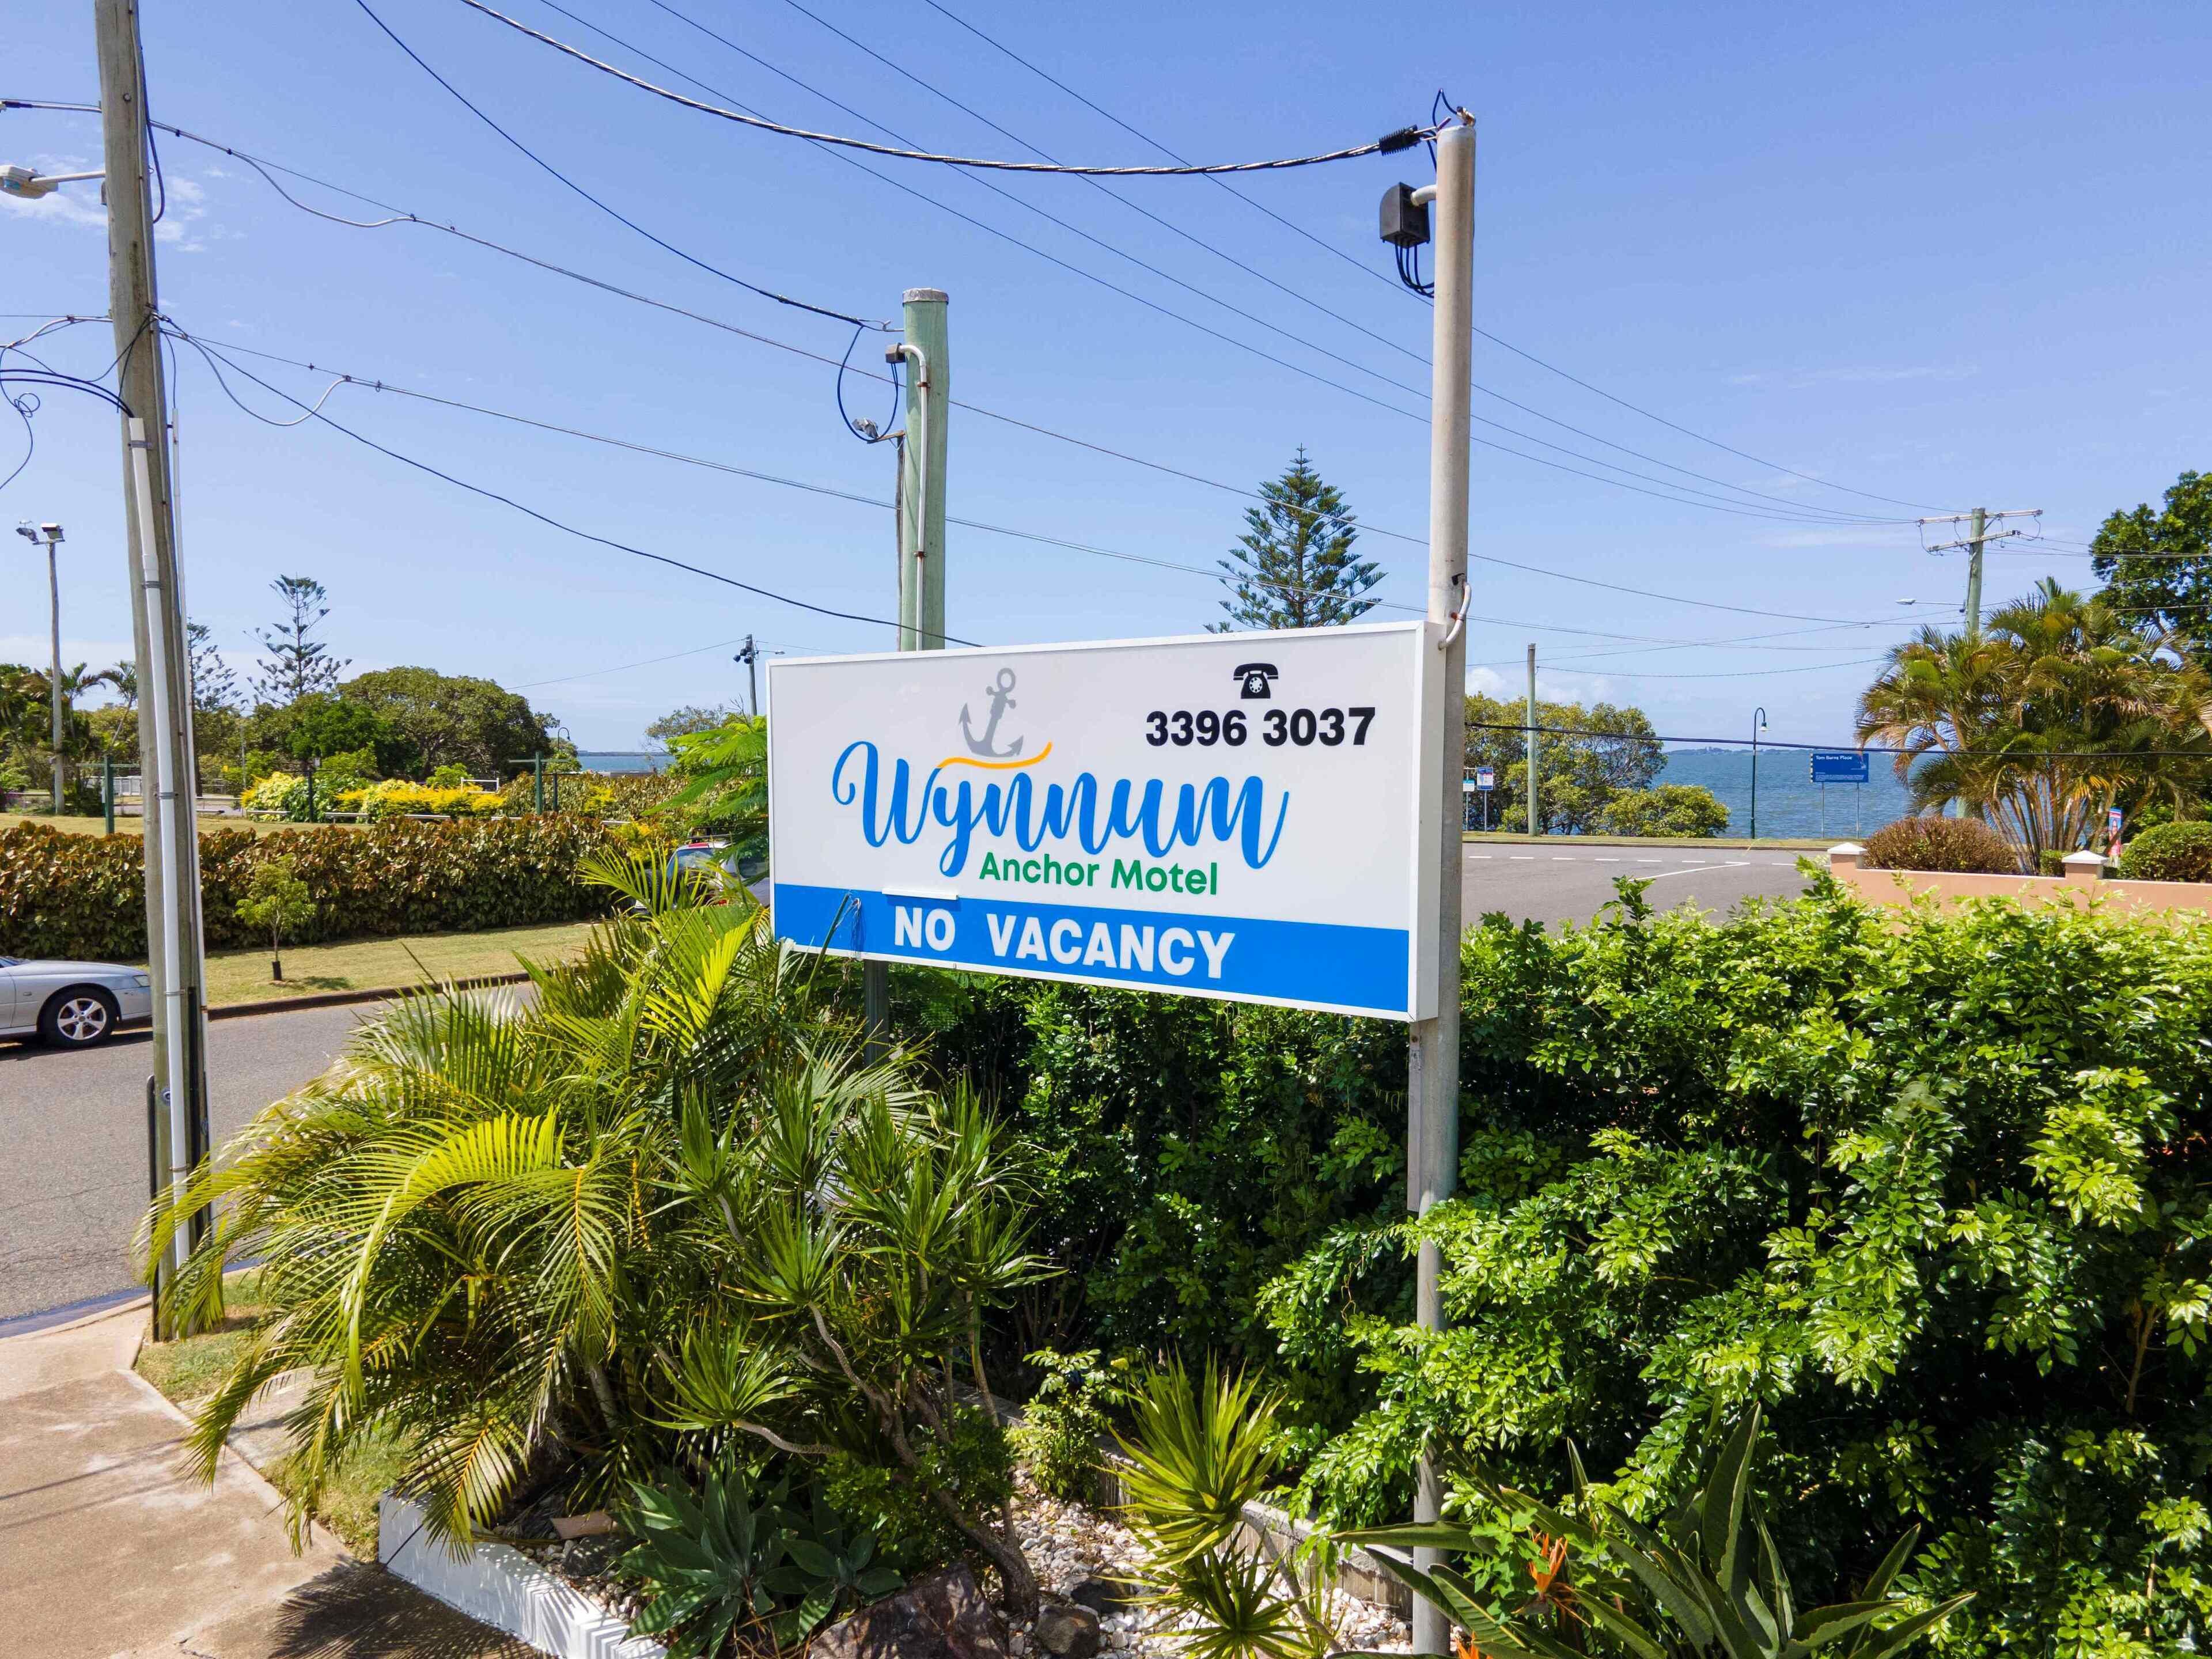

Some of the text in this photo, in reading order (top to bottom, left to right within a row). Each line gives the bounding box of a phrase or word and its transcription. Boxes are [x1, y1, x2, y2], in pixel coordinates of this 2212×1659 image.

[1146, 707, 1376, 747] 3396 3037
[832, 740, 1290, 878] Wynnum
[979, 851, 1218, 895] Anchor Motel
[894, 906, 1236, 979] NO VACANCY
